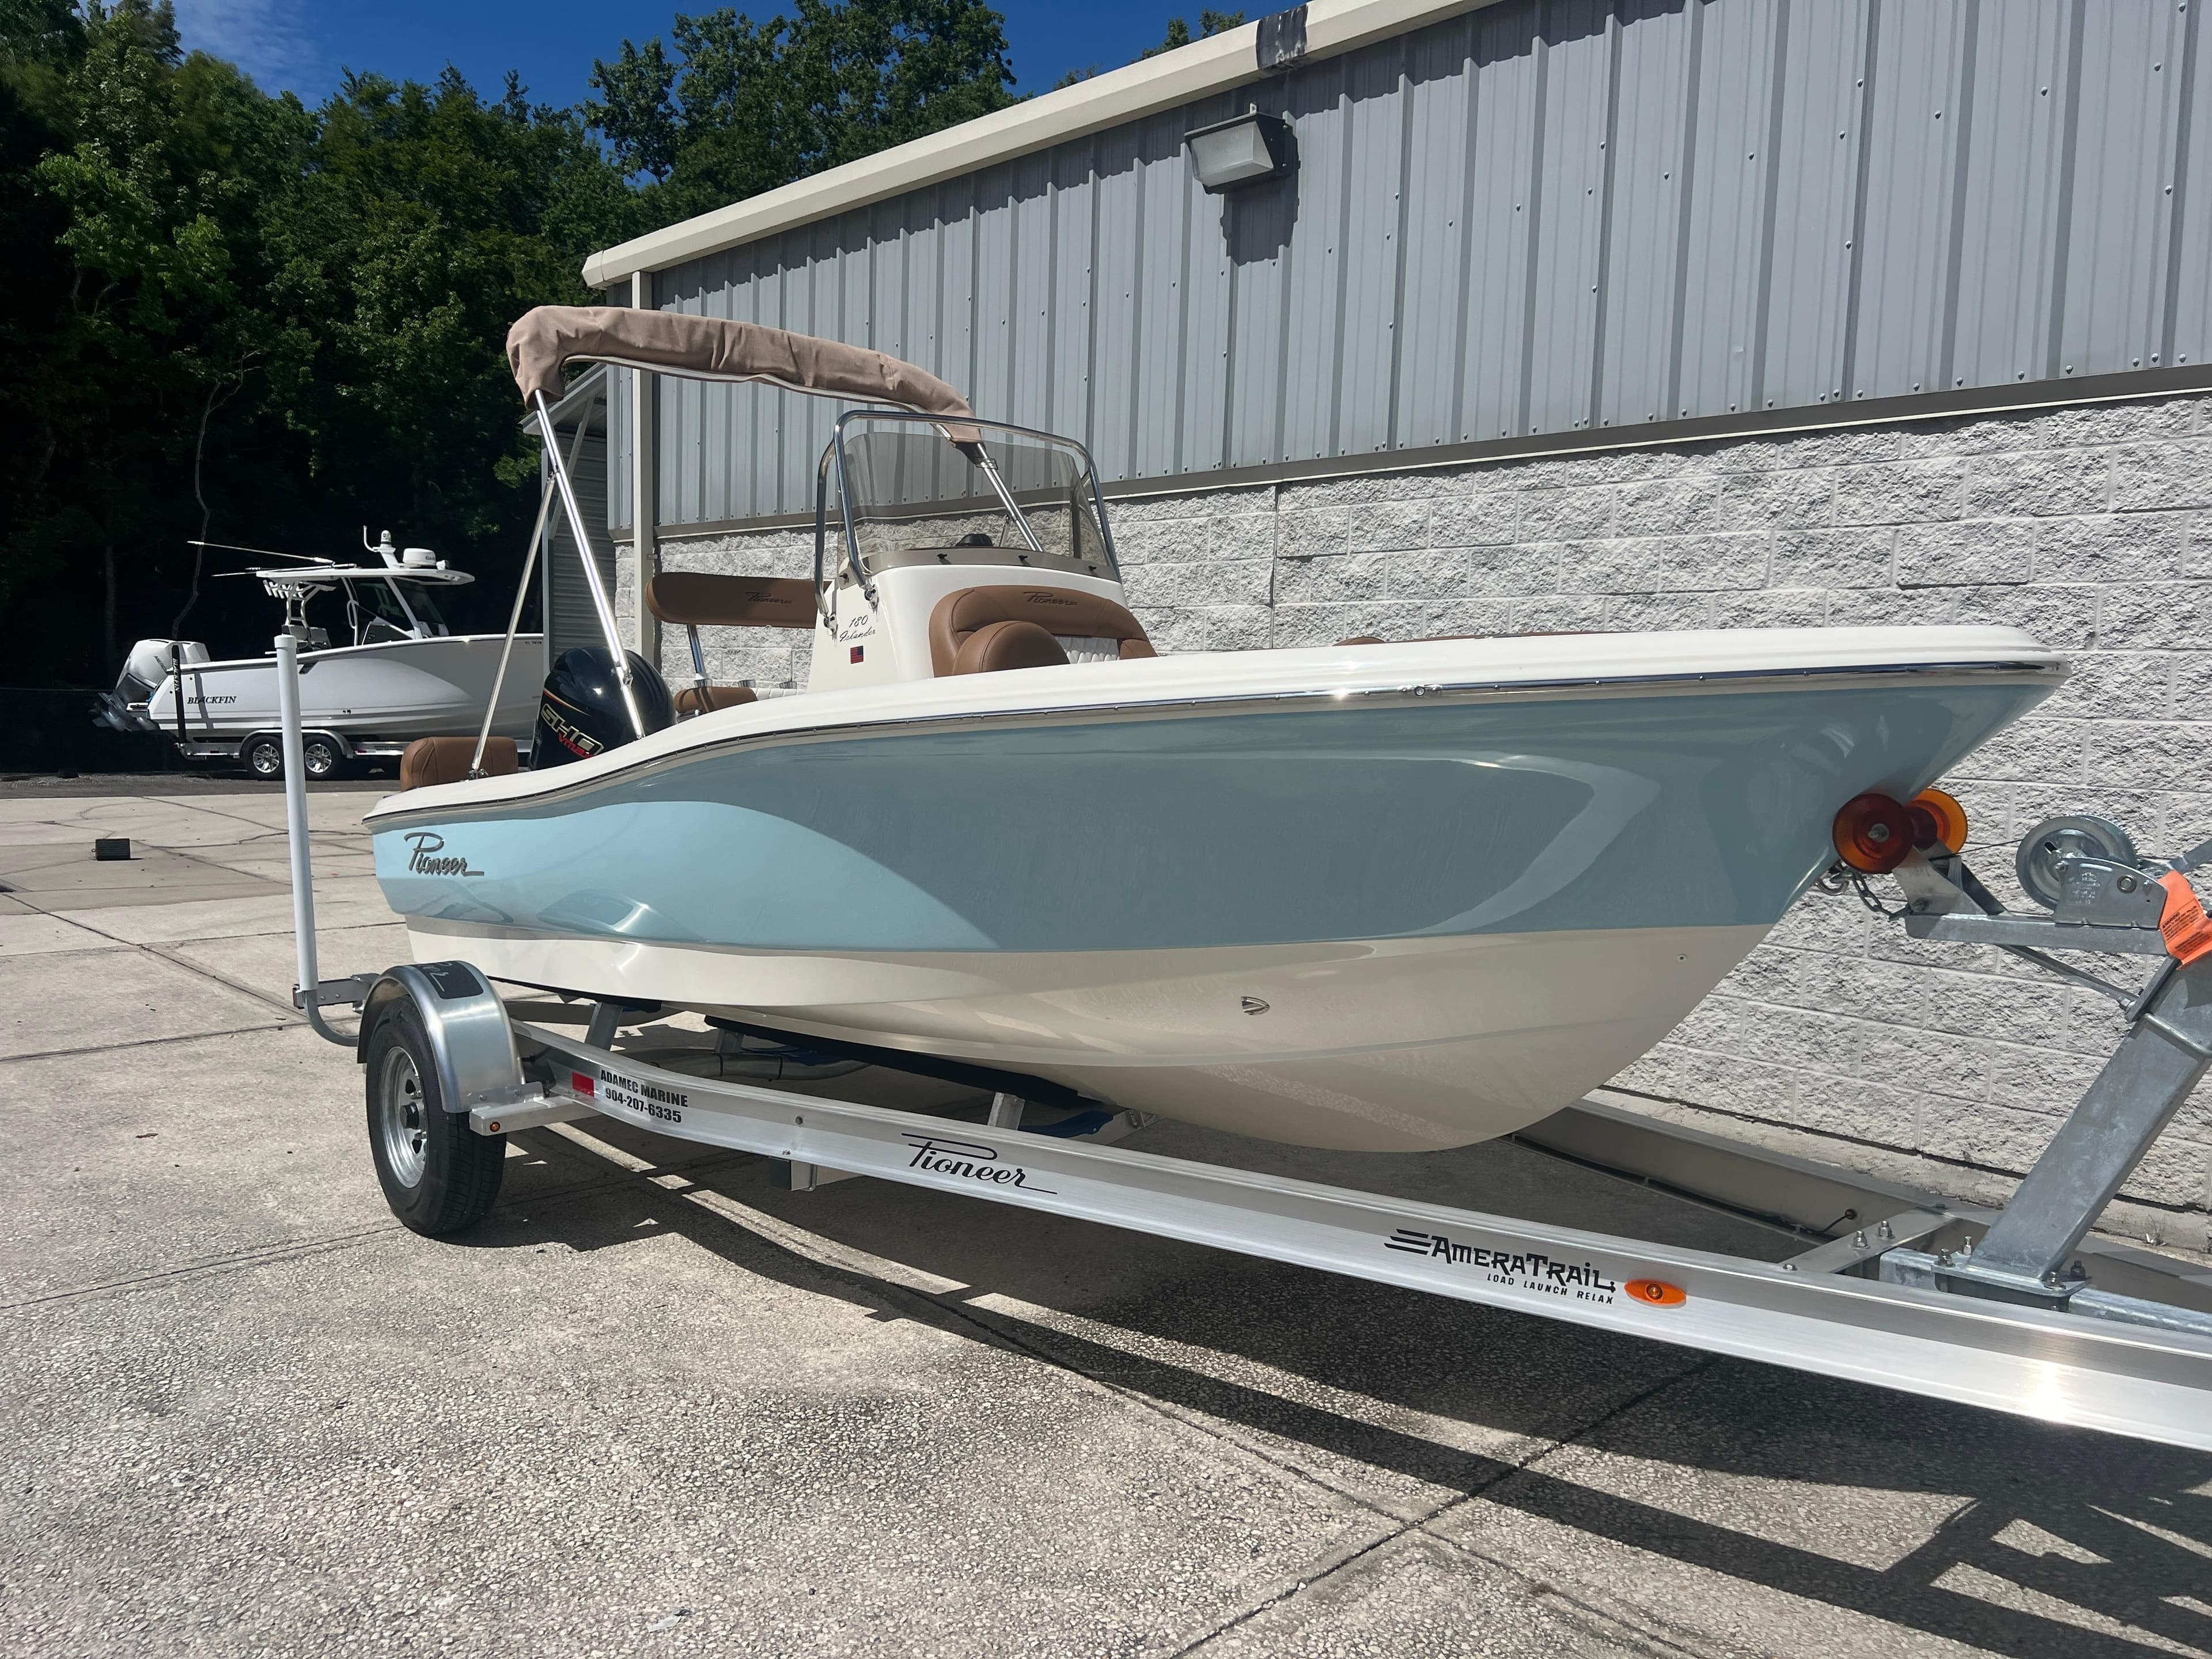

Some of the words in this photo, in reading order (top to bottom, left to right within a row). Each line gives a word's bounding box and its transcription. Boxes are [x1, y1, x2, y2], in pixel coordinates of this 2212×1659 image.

[1023, 591, 1079, 606] Pioneer
[839, 626, 876, 642] Islander
[849, 615, 869, 628] 180
[187, 695, 237, 704] BLACKFIN
[541, 703, 604, 756] SHO
[404, 832, 485, 877] Pioneer
[601, 1070, 639, 1094] ADAMEC
[641, 1084, 688, 1108] MARINE
[605, 1087, 682, 1123] 904-207-6335
[901, 1132, 1058, 1195] Pioneer
[1487, 1272, 1514, 1286] LOAD
[1523, 1281, 1568, 1296] LAUNCH
[1576, 1290, 1614, 1305] RELAX
